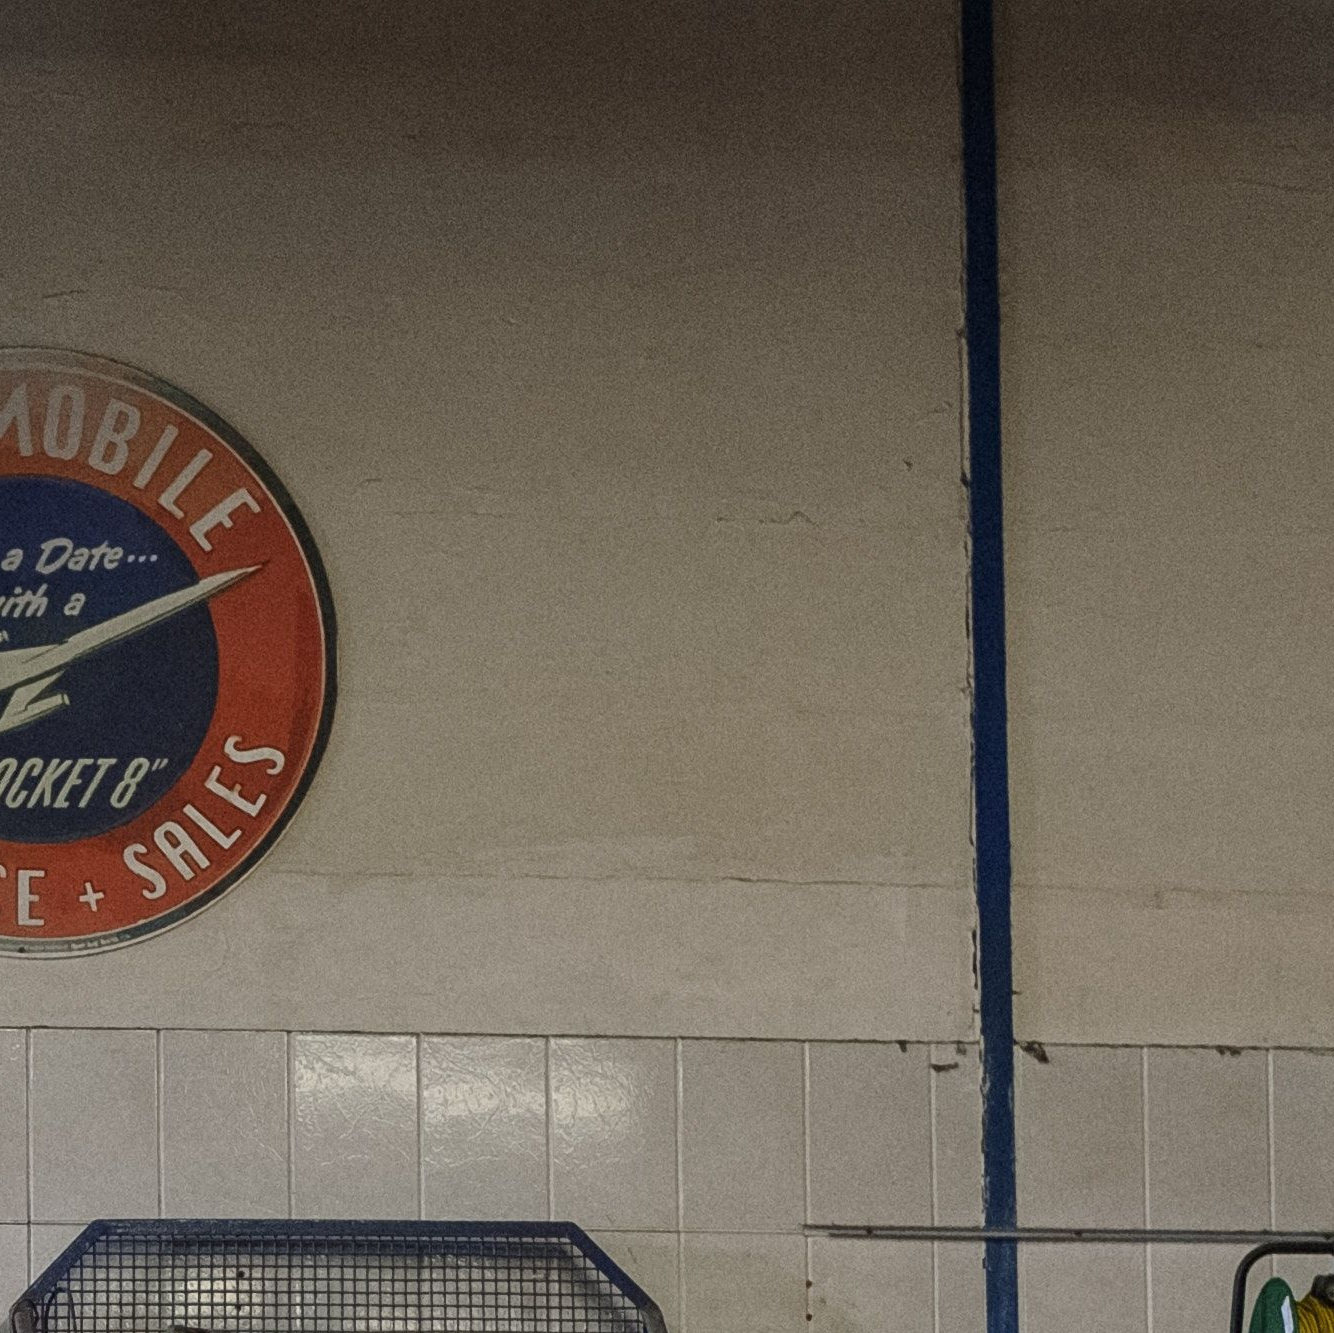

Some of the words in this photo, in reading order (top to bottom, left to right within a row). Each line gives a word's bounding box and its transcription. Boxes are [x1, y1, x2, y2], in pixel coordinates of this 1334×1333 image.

[1, 551, 24, 573] a
[64, 592, 86, 618] a
[122, 735, 286, 901] SALES
